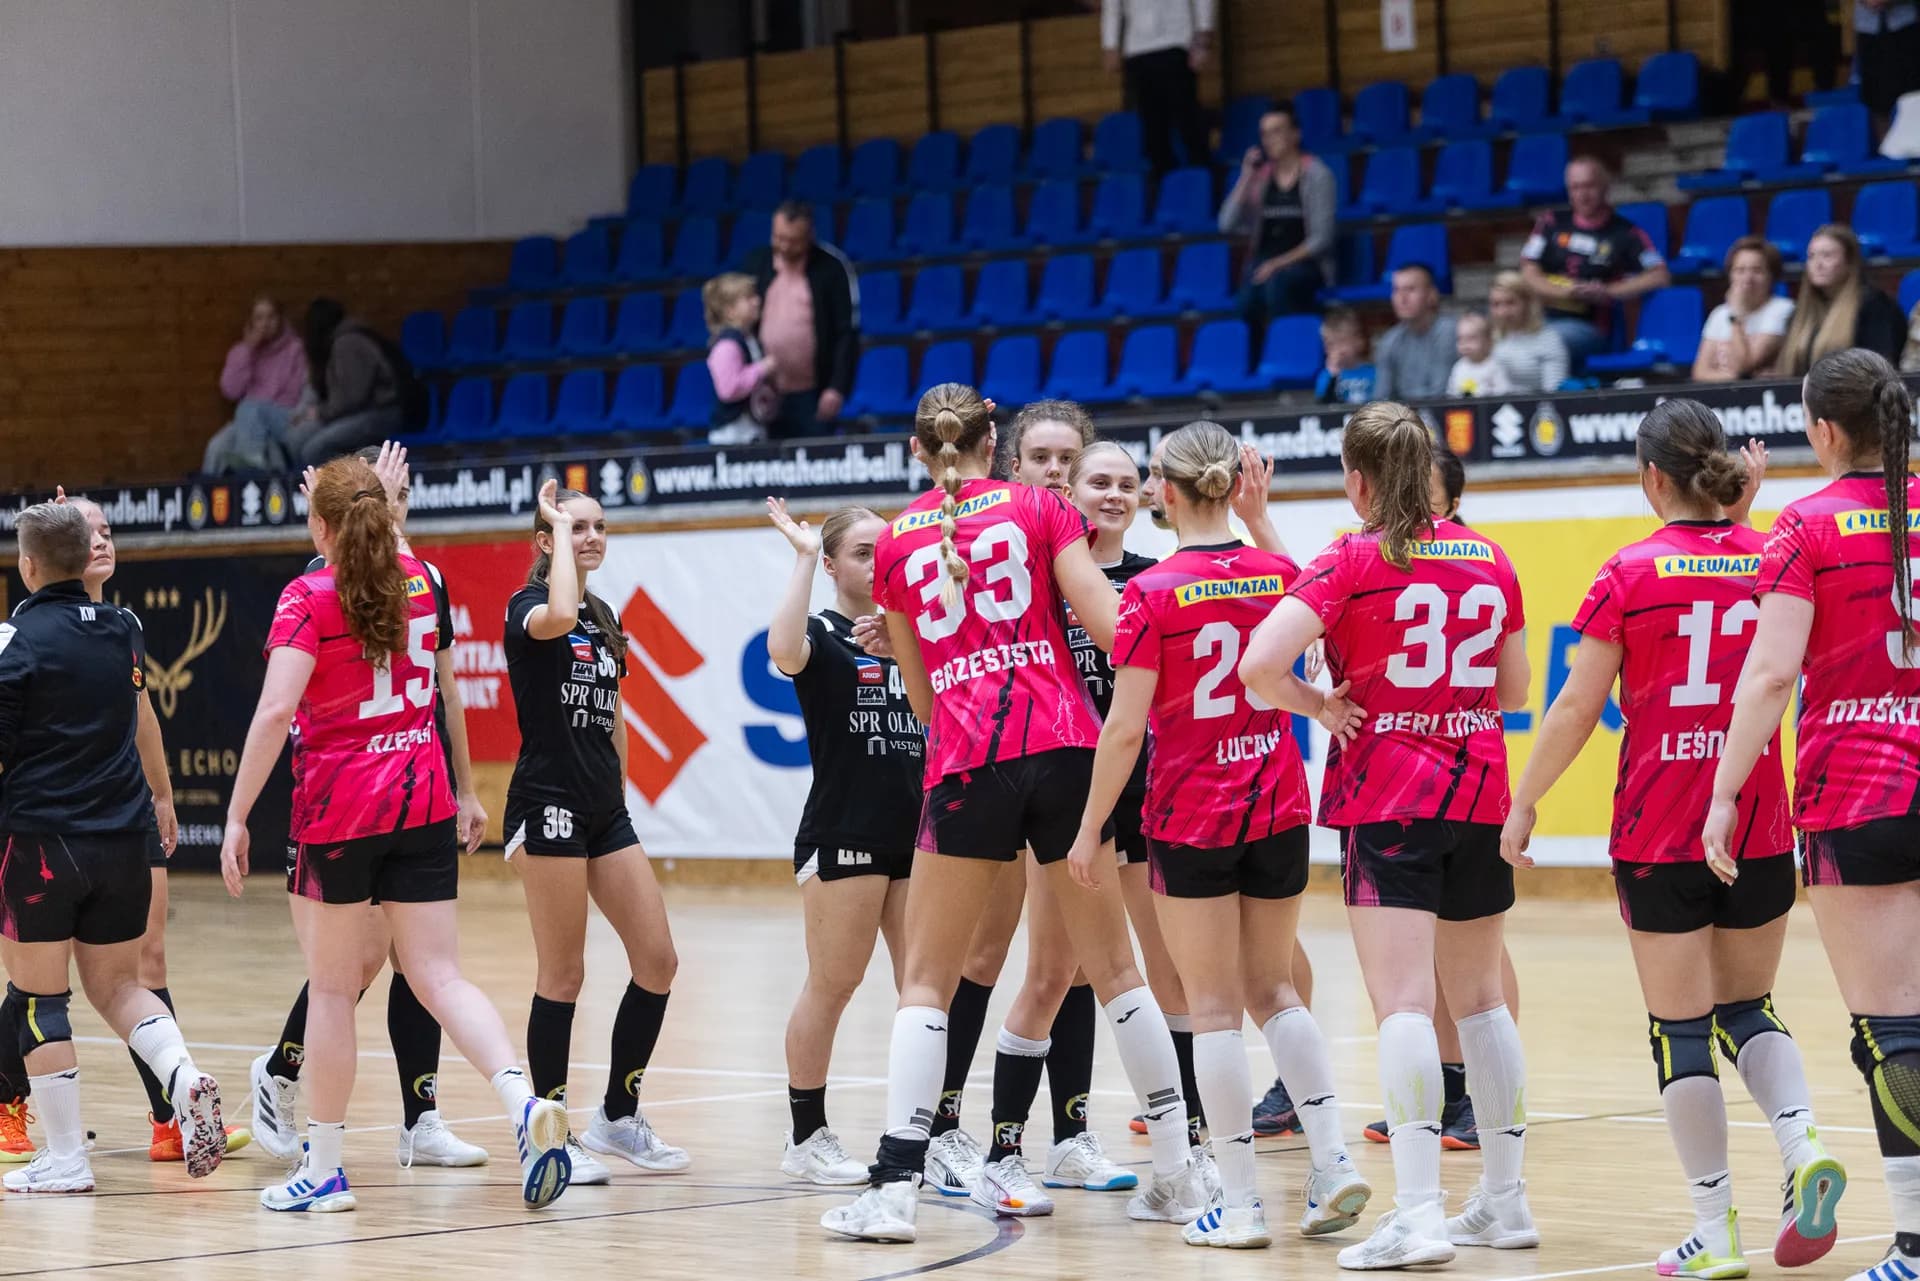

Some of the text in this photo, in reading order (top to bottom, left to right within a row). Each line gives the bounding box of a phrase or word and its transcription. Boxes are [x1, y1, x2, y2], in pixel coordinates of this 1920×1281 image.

[653, 443, 930, 492] www.koronahandball.p
[1688, 557, 1760, 573] LEWIATA
[905, 521, 1032, 644] 33
[1205, 577, 1278, 597] LEWIATAN
[1384, 583, 1508, 688] 32
[359, 613, 437, 720] 15
[931, 641, 1055, 694] GRZESISTA
[1074, 650, 1098, 672] PR
[561, 682, 590, 706] SPR
[1826, 692, 1920, 726] MIŚKI
[849, 711, 882, 733] SPR
[180, 749, 239, 776] ECHO
[543, 805, 573, 839] 36
